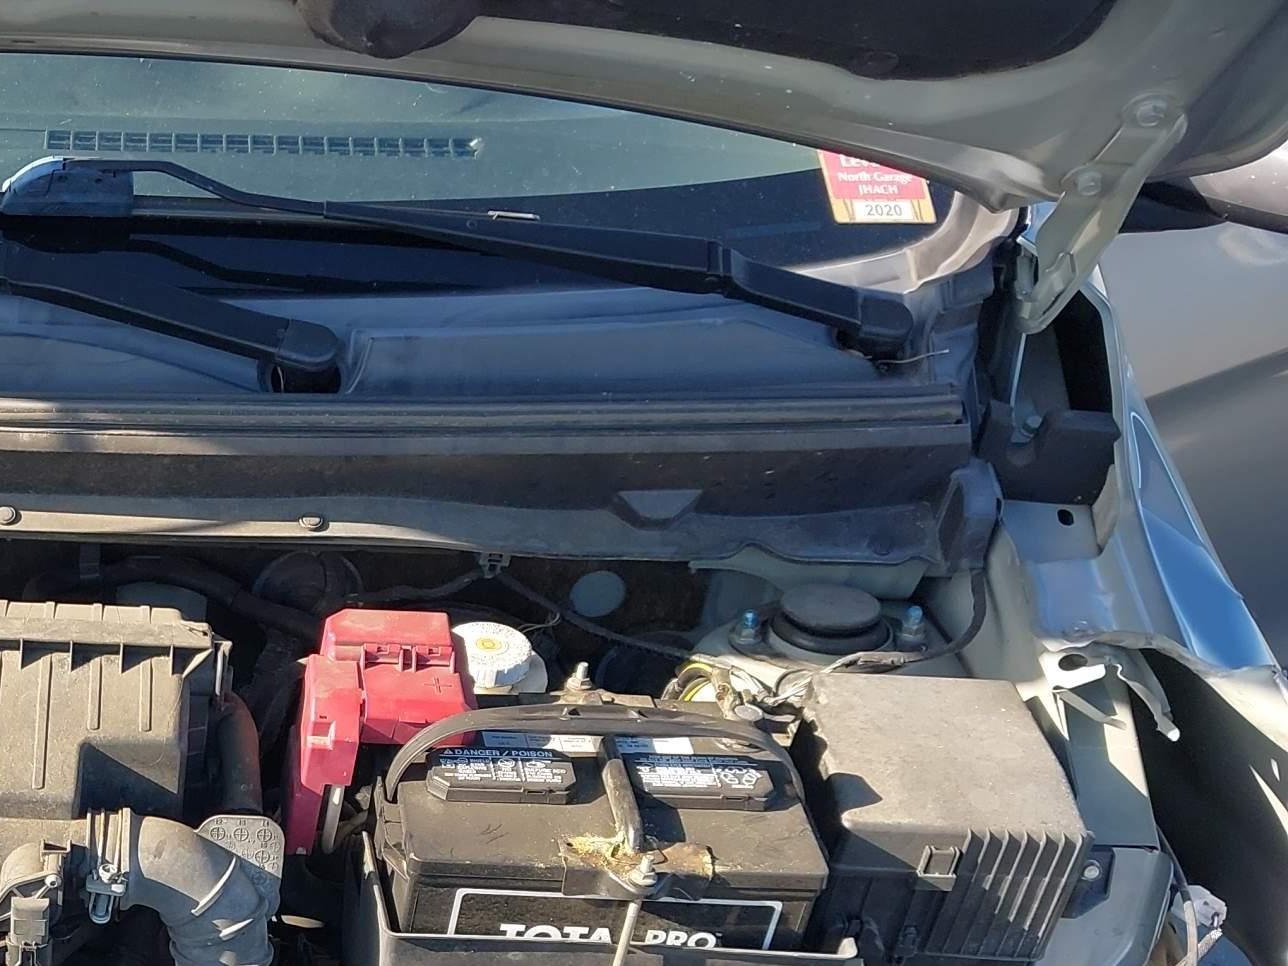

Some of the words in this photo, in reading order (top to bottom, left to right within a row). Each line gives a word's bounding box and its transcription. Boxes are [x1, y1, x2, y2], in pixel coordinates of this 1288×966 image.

[838, 171, 871, 181] North
[873, 171, 912, 184] Garage
[867, 204, 903, 217] 2020
